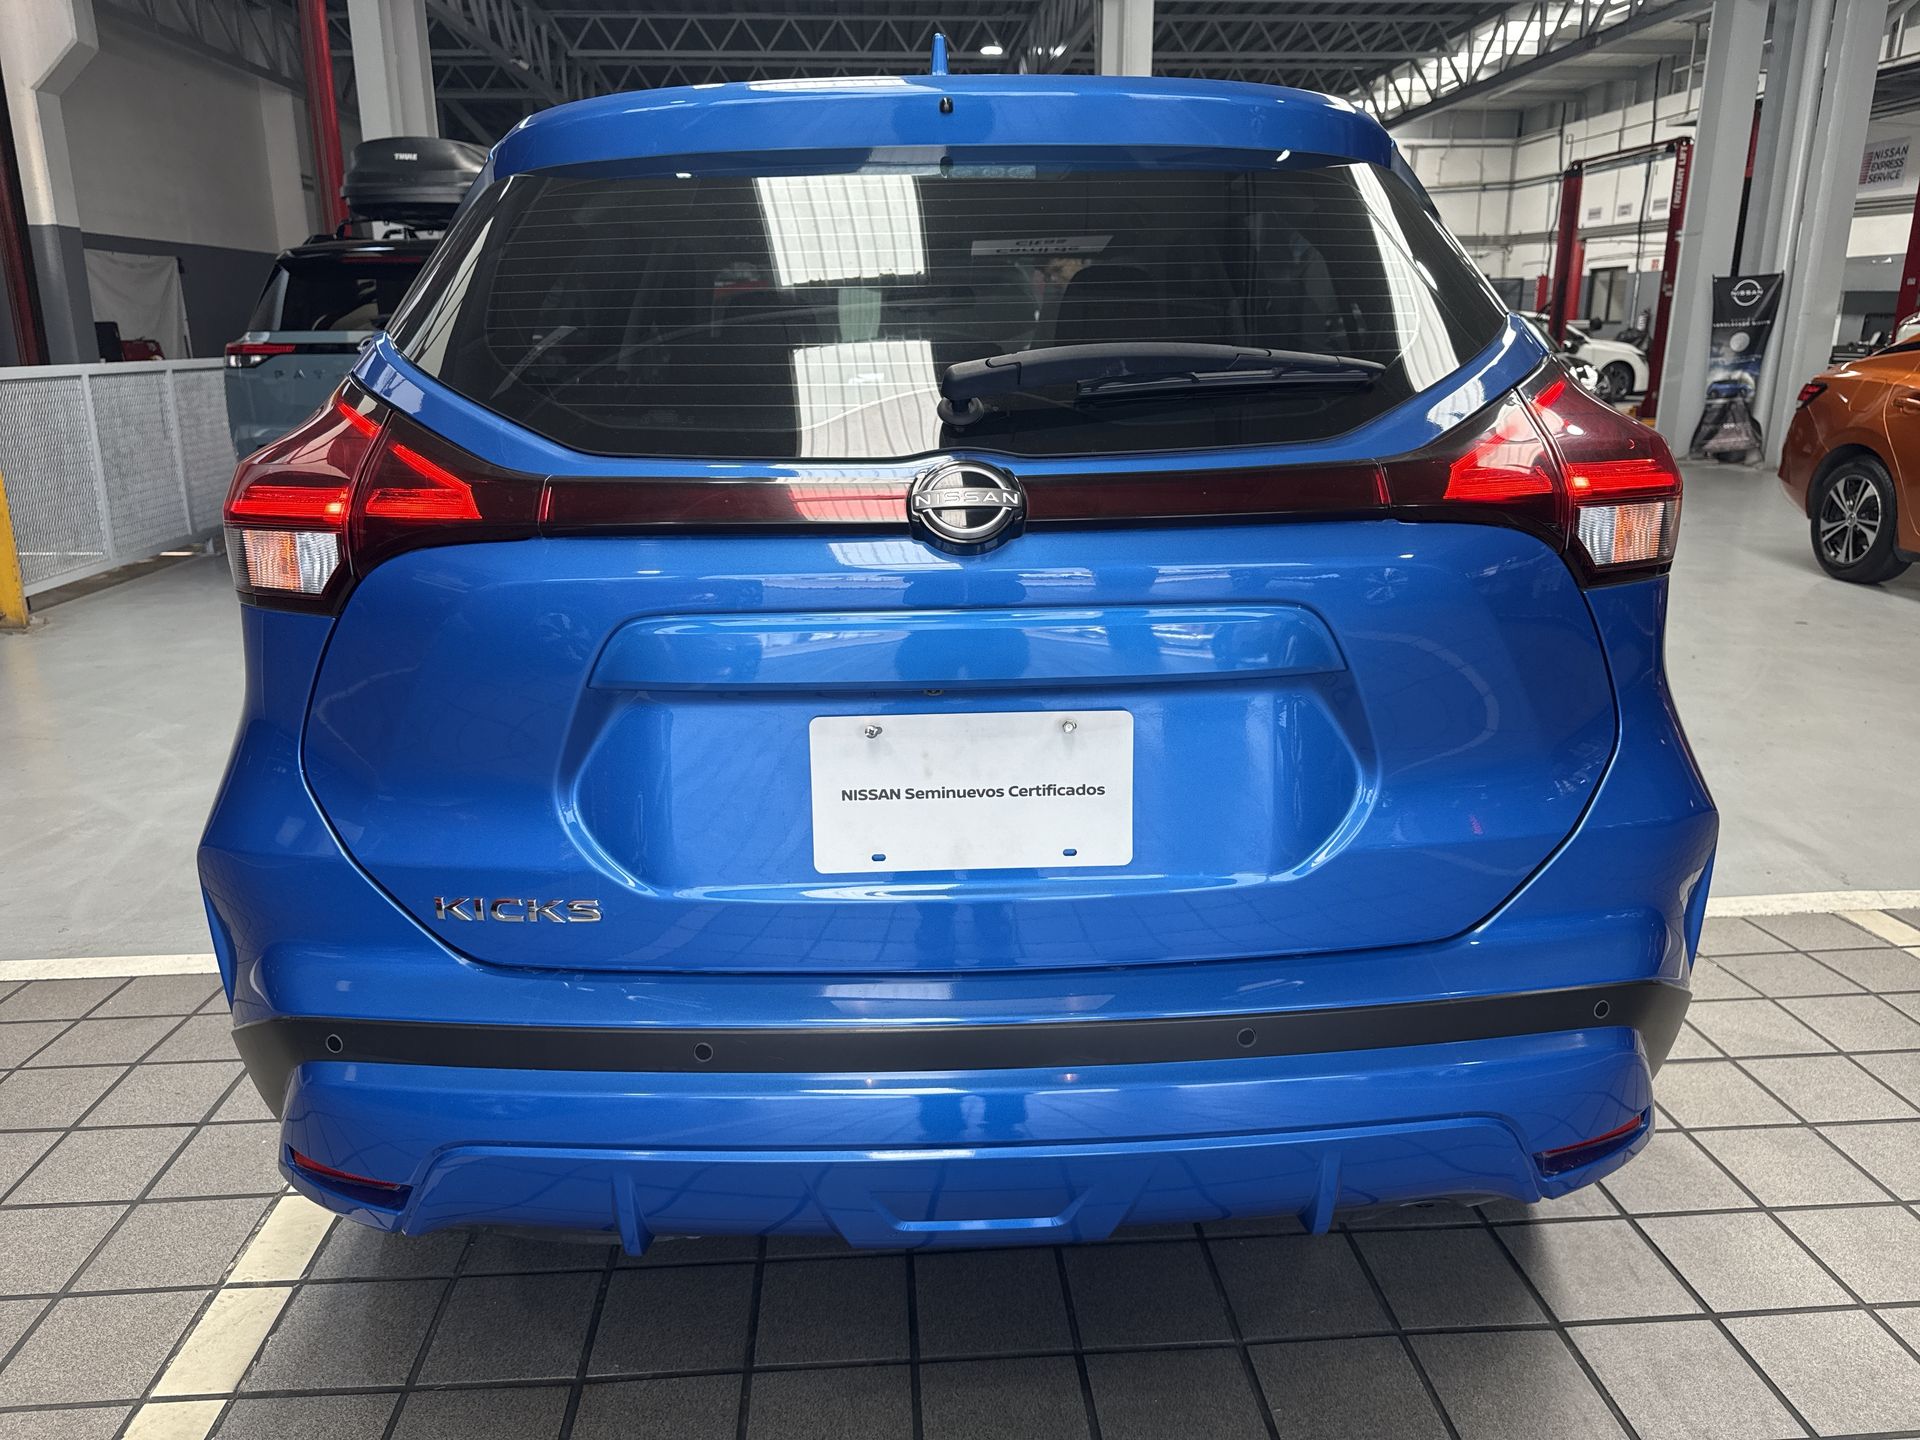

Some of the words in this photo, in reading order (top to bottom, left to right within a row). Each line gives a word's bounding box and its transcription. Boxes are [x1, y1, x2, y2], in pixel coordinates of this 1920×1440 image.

[1874, 145, 1910, 160] NISSAN
[1871, 157, 1905, 172] EXPRESS
[1868, 169, 1901, 184] SERVICE
[915, 491, 1019, 507] NISSAN
[841, 788, 901, 801] NISSAN
[905, 786, 1005, 800] Seminuevos
[1008, 783, 1106, 797] Certificados
[434, 897, 603, 923] KICKS
